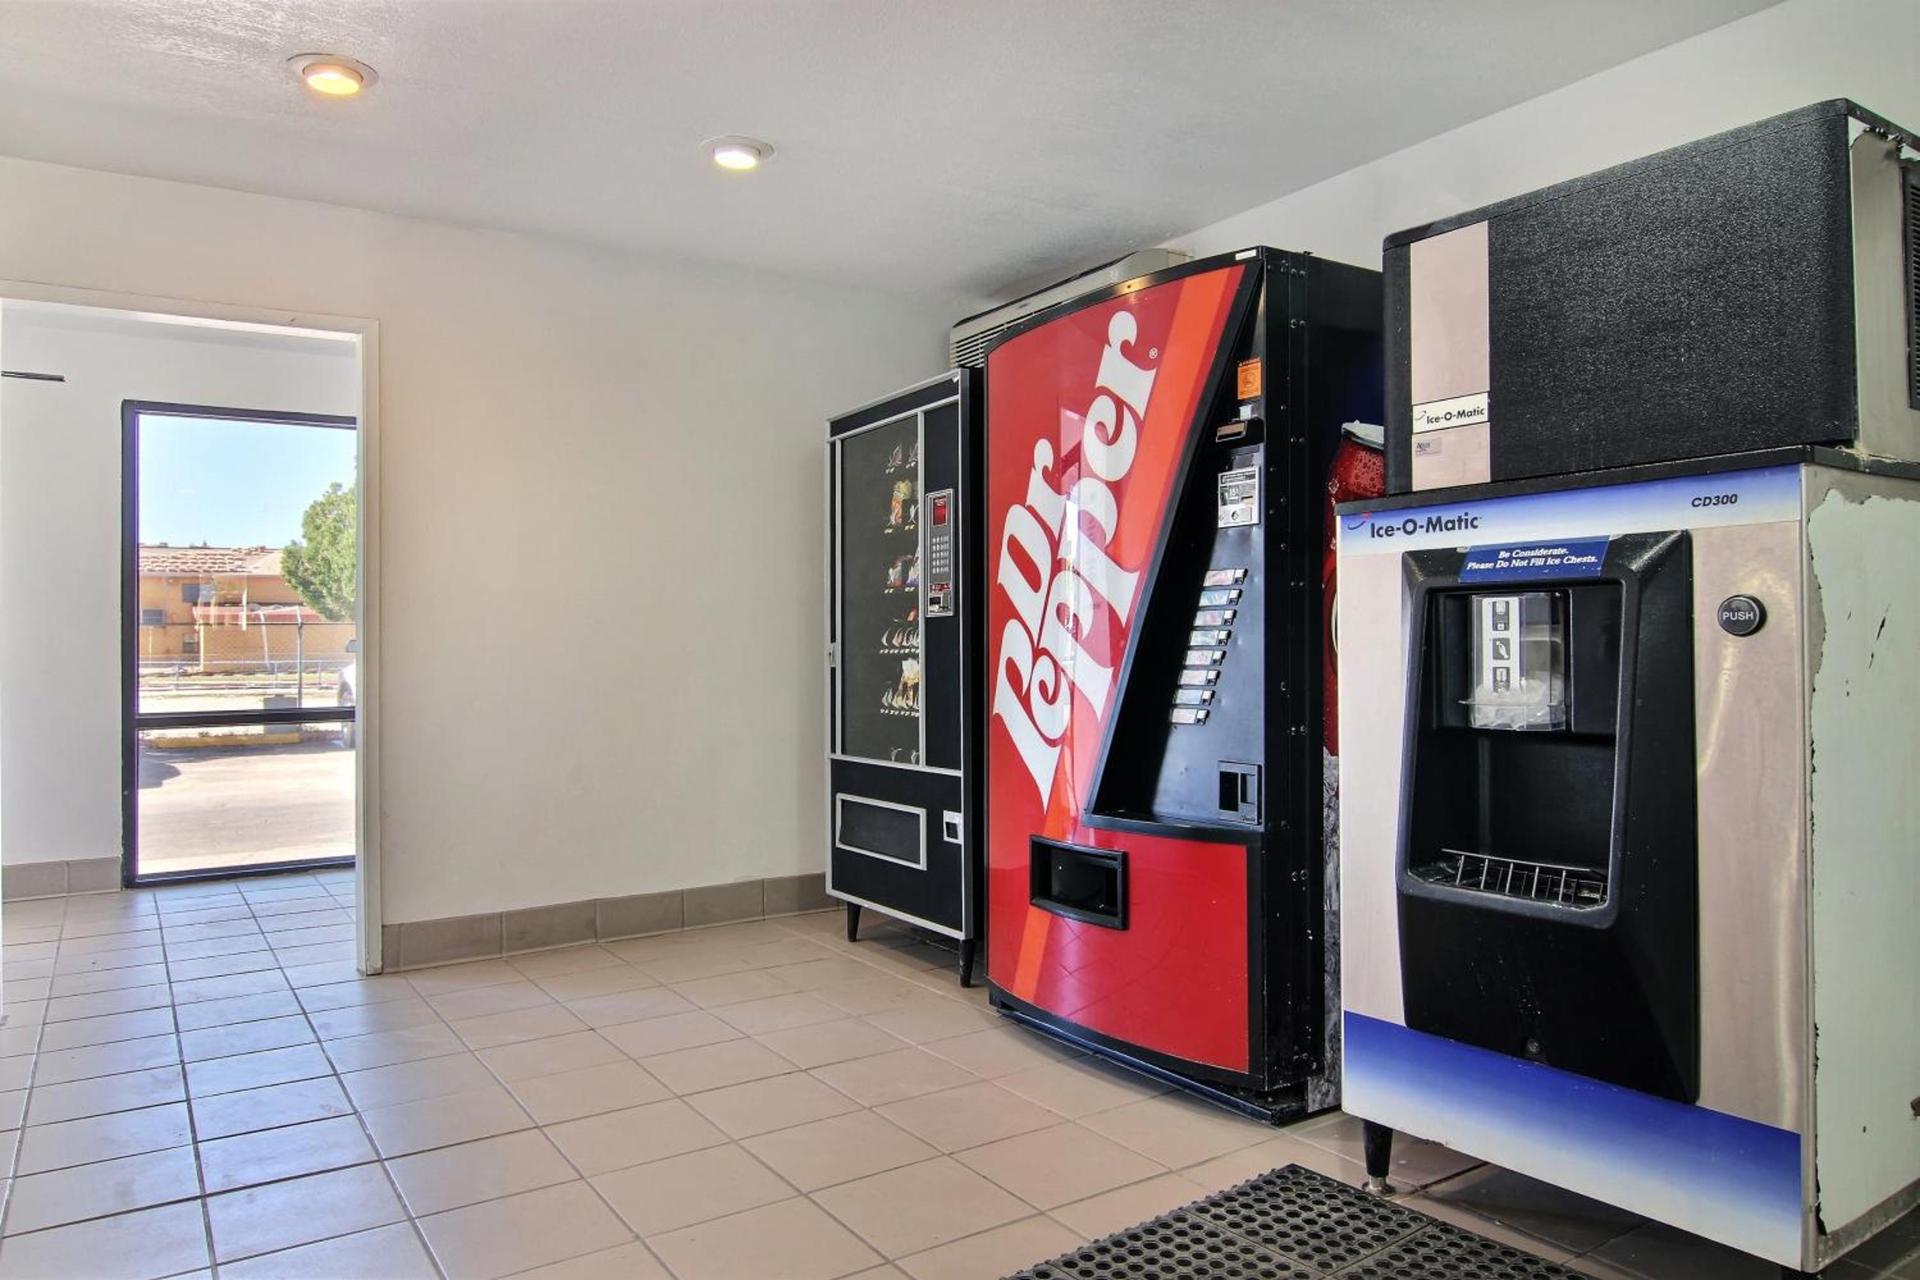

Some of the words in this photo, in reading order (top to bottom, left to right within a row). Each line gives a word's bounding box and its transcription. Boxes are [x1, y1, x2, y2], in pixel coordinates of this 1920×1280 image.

[1427, 406, 1485, 424] Ice-O-Matic
[1691, 493, 1738, 507] CD300
[1370, 512, 1479, 538] Ice-O-Matic
[997, 438, 1068, 645] Dr
[1498, 550, 1510, 558] Be
[1512, 547, 1569, 558] Considerate.
[993, 310, 1157, 815] Pepper
[1466, 561, 1495, 570] Please
[1496, 559, 1509, 568] Do
[1511, 559, 1528, 567] Not
[1530, 557, 1545, 566] Fill
[1546, 557, 1561, 565] Ice
[1563, 555, 1599, 564] Chests.
[1722, 611, 1754, 621] PUSH
